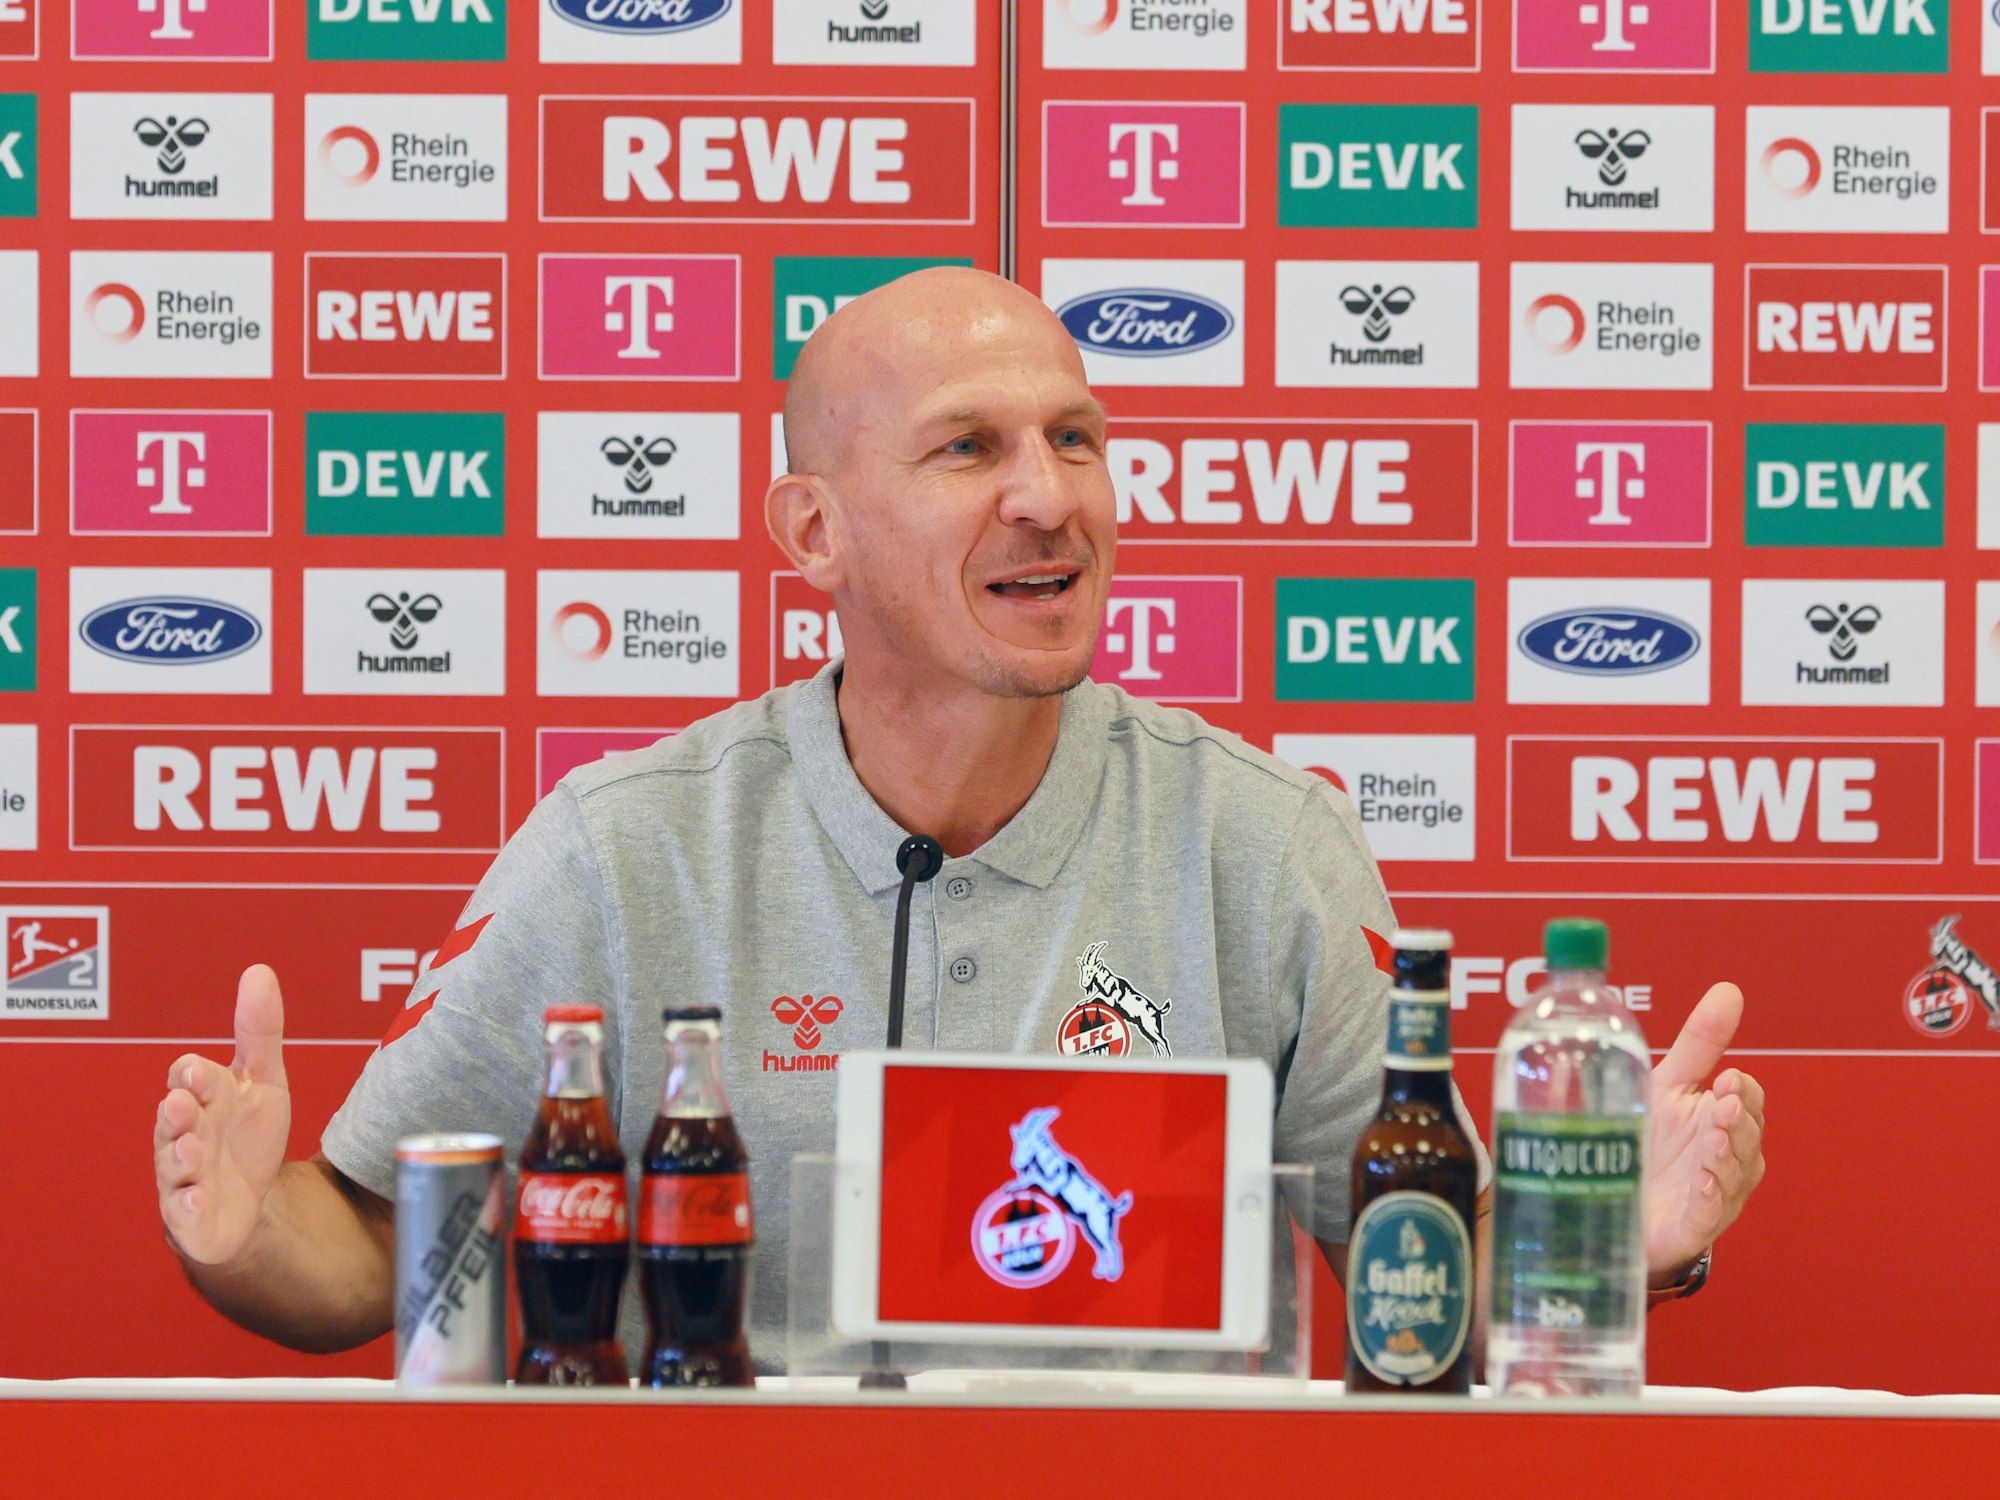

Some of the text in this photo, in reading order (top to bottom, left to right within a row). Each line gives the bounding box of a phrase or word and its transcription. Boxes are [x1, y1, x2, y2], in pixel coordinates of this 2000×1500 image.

[1132, 8, 1232, 35] Energie
[1291, 0, 1467, 33] REWE
[1763, 0, 1934, 34] DEVK
[829, 20, 920, 42] hummel
[393, 134, 467, 155] Rhein
[1835, 147, 1908, 167] Rhein
[604, 117, 910, 202] REWE
[1110, 124, 1178, 205] T
[1292, 144, 1463, 188] DEVK
[126, 174, 217, 196] hummel
[393, 160, 494, 187] Energie
[1834, 172, 1936, 198] Energie
[1567, 186, 1658, 208] hummel
[158, 291, 232, 312] Rhein
[1599, 303, 1672, 324] Rhein
[318, 291, 492, 340] REWE
[606, 277, 673, 358] T
[1088, 298, 1197, 344] Ford
[1758, 303, 1933, 352] REWE
[158, 317, 259, 344] Energie
[1598, 328, 1700, 355] Energie
[1331, 343, 1423, 365] hummel
[138, 432, 204, 513] T
[319, 452, 489, 496] DEVK
[1106, 439, 1412, 524] REWE
[1577, 443, 1644, 524] T
[1758, 463, 1929, 508] DEVK
[593, 494, 684, 516] hummel
[116, 606, 224, 652] Ford
[625, 610, 699, 632] Rhein
[625, 636, 726, 663] Energie
[1106, 598, 1175, 680] T
[1289, 618, 1459, 662] DEVK
[1554, 617, 1663, 663] Ford
[358, 650, 450, 672] hummel
[1797, 661, 1889, 683] hummel
[134, 747, 439, 831] REWE
[1361, 775, 1435, 796] Rhein
[1361, 800, 1462, 827] Energie
[1572, 758, 1877, 842] REWE
[68, 953, 93, 986] 2
[6, 998, 98, 1010] BUNDESLIGA
[1073, 1025, 1113, 1053] 1.FC
[763, 1049, 839, 1071] humm
